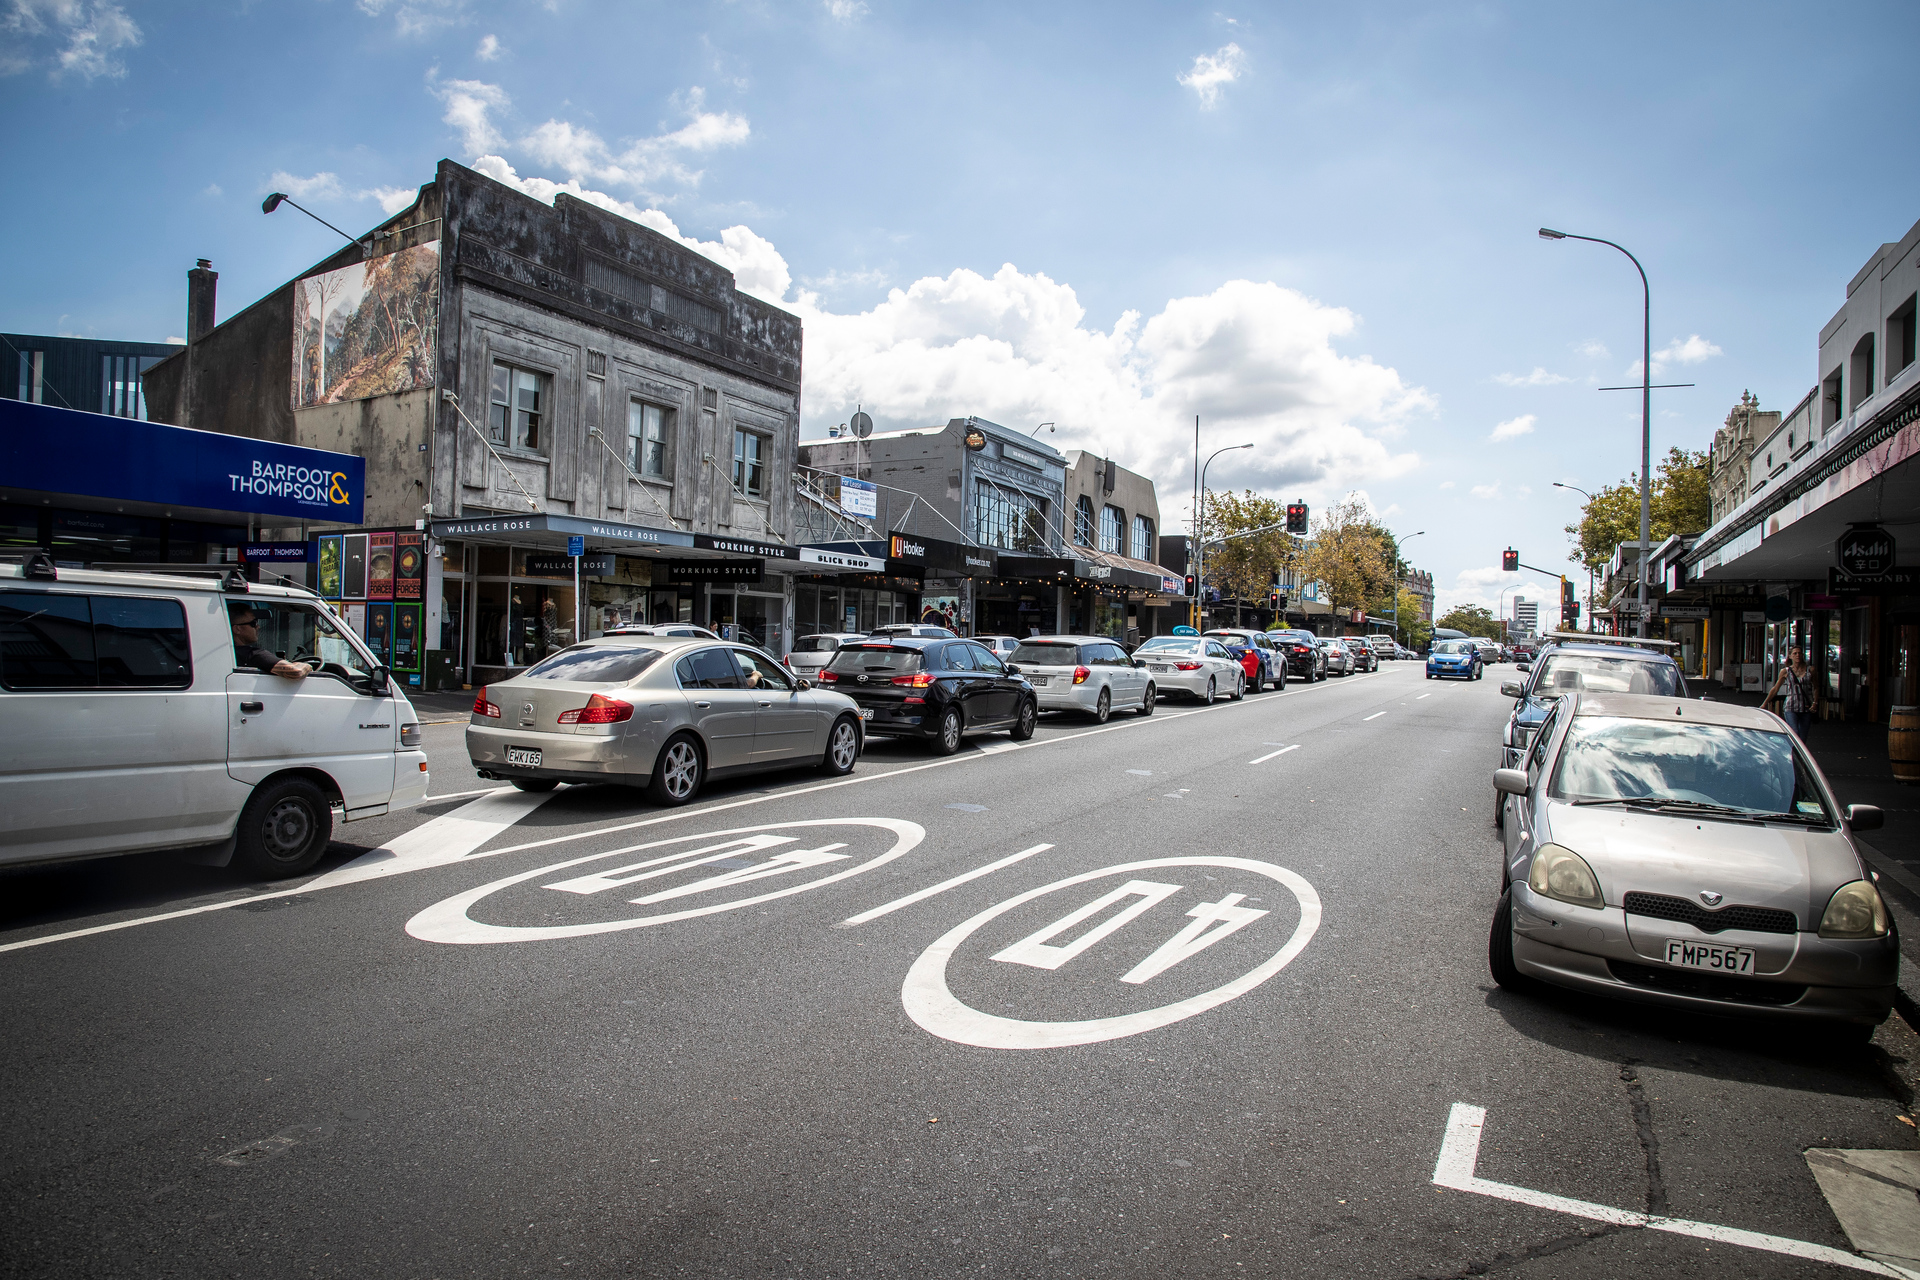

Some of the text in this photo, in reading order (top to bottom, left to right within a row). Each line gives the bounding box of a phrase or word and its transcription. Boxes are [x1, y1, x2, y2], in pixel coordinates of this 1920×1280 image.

[252, 460, 332, 486] BARFOOT
[228, 474, 328, 502] THOMPSON
[329, 471, 350, 505] &
[841, 477, 862, 490] For Lease
[67, 519, 105, 529] barfoot.co.nz
[447, 521, 531, 534] WALLACE ROSE
[592, 525, 658, 541] WALLACE ROSE
[246, 548, 270, 556] BARFOOT
[274, 548, 304, 556] THOMPSON
[713, 540, 785, 557] WORKING STYLE
[903, 539, 925, 557] Hooker
[1844, 541, 1889, 557] Asahi
[534, 561, 607, 570] WALLAC ROSE
[817, 554, 869, 568] SLICK SHOP
[1855, 559, 1879, 570] 辛口
[725, 567, 757, 575] STYLE
[371, 585, 392, 594] FORCES
[398, 585, 420, 594] FORCES
[1715, 596, 1759, 604] masons
[508, 751, 541, 765] EWK165
[541, 834, 851, 905] 40
[988, 879, 1270, 985] 40
[1668, 943, 1752, 971] FMP567
